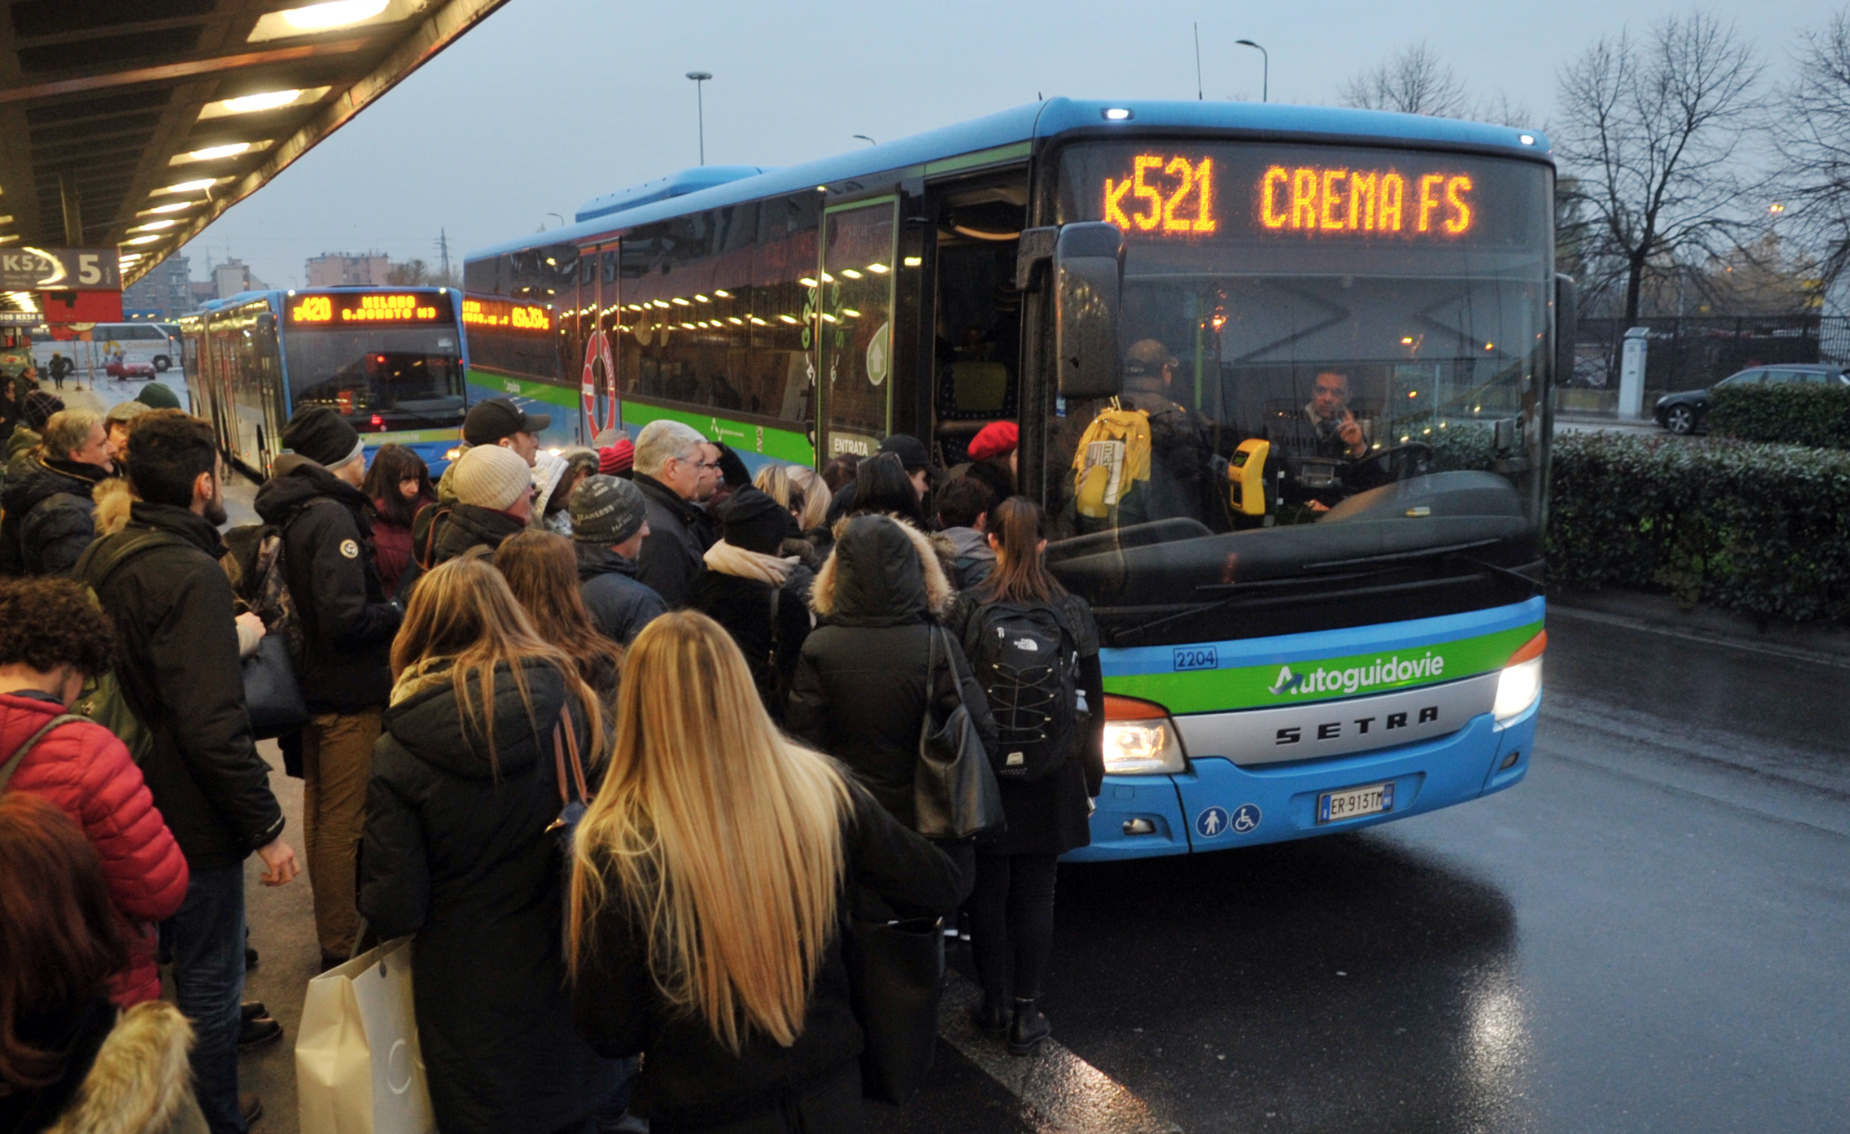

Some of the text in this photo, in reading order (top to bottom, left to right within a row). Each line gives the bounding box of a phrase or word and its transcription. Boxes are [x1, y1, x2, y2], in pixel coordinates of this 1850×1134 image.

[1104, 155, 1472, 233] K521 CREMA FS
[3, 254, 58, 271] K52
[79, 254, 101, 284] 5
[362, 296, 415, 309] MILANO
[834, 437, 869, 456] ENTRATA
[1177, 650, 1214, 668] 2204
[1268, 651, 1444, 696] Autoguidovie
[1276, 706, 1438, 745] SETRA
[1331, 797, 1346, 816] ER
